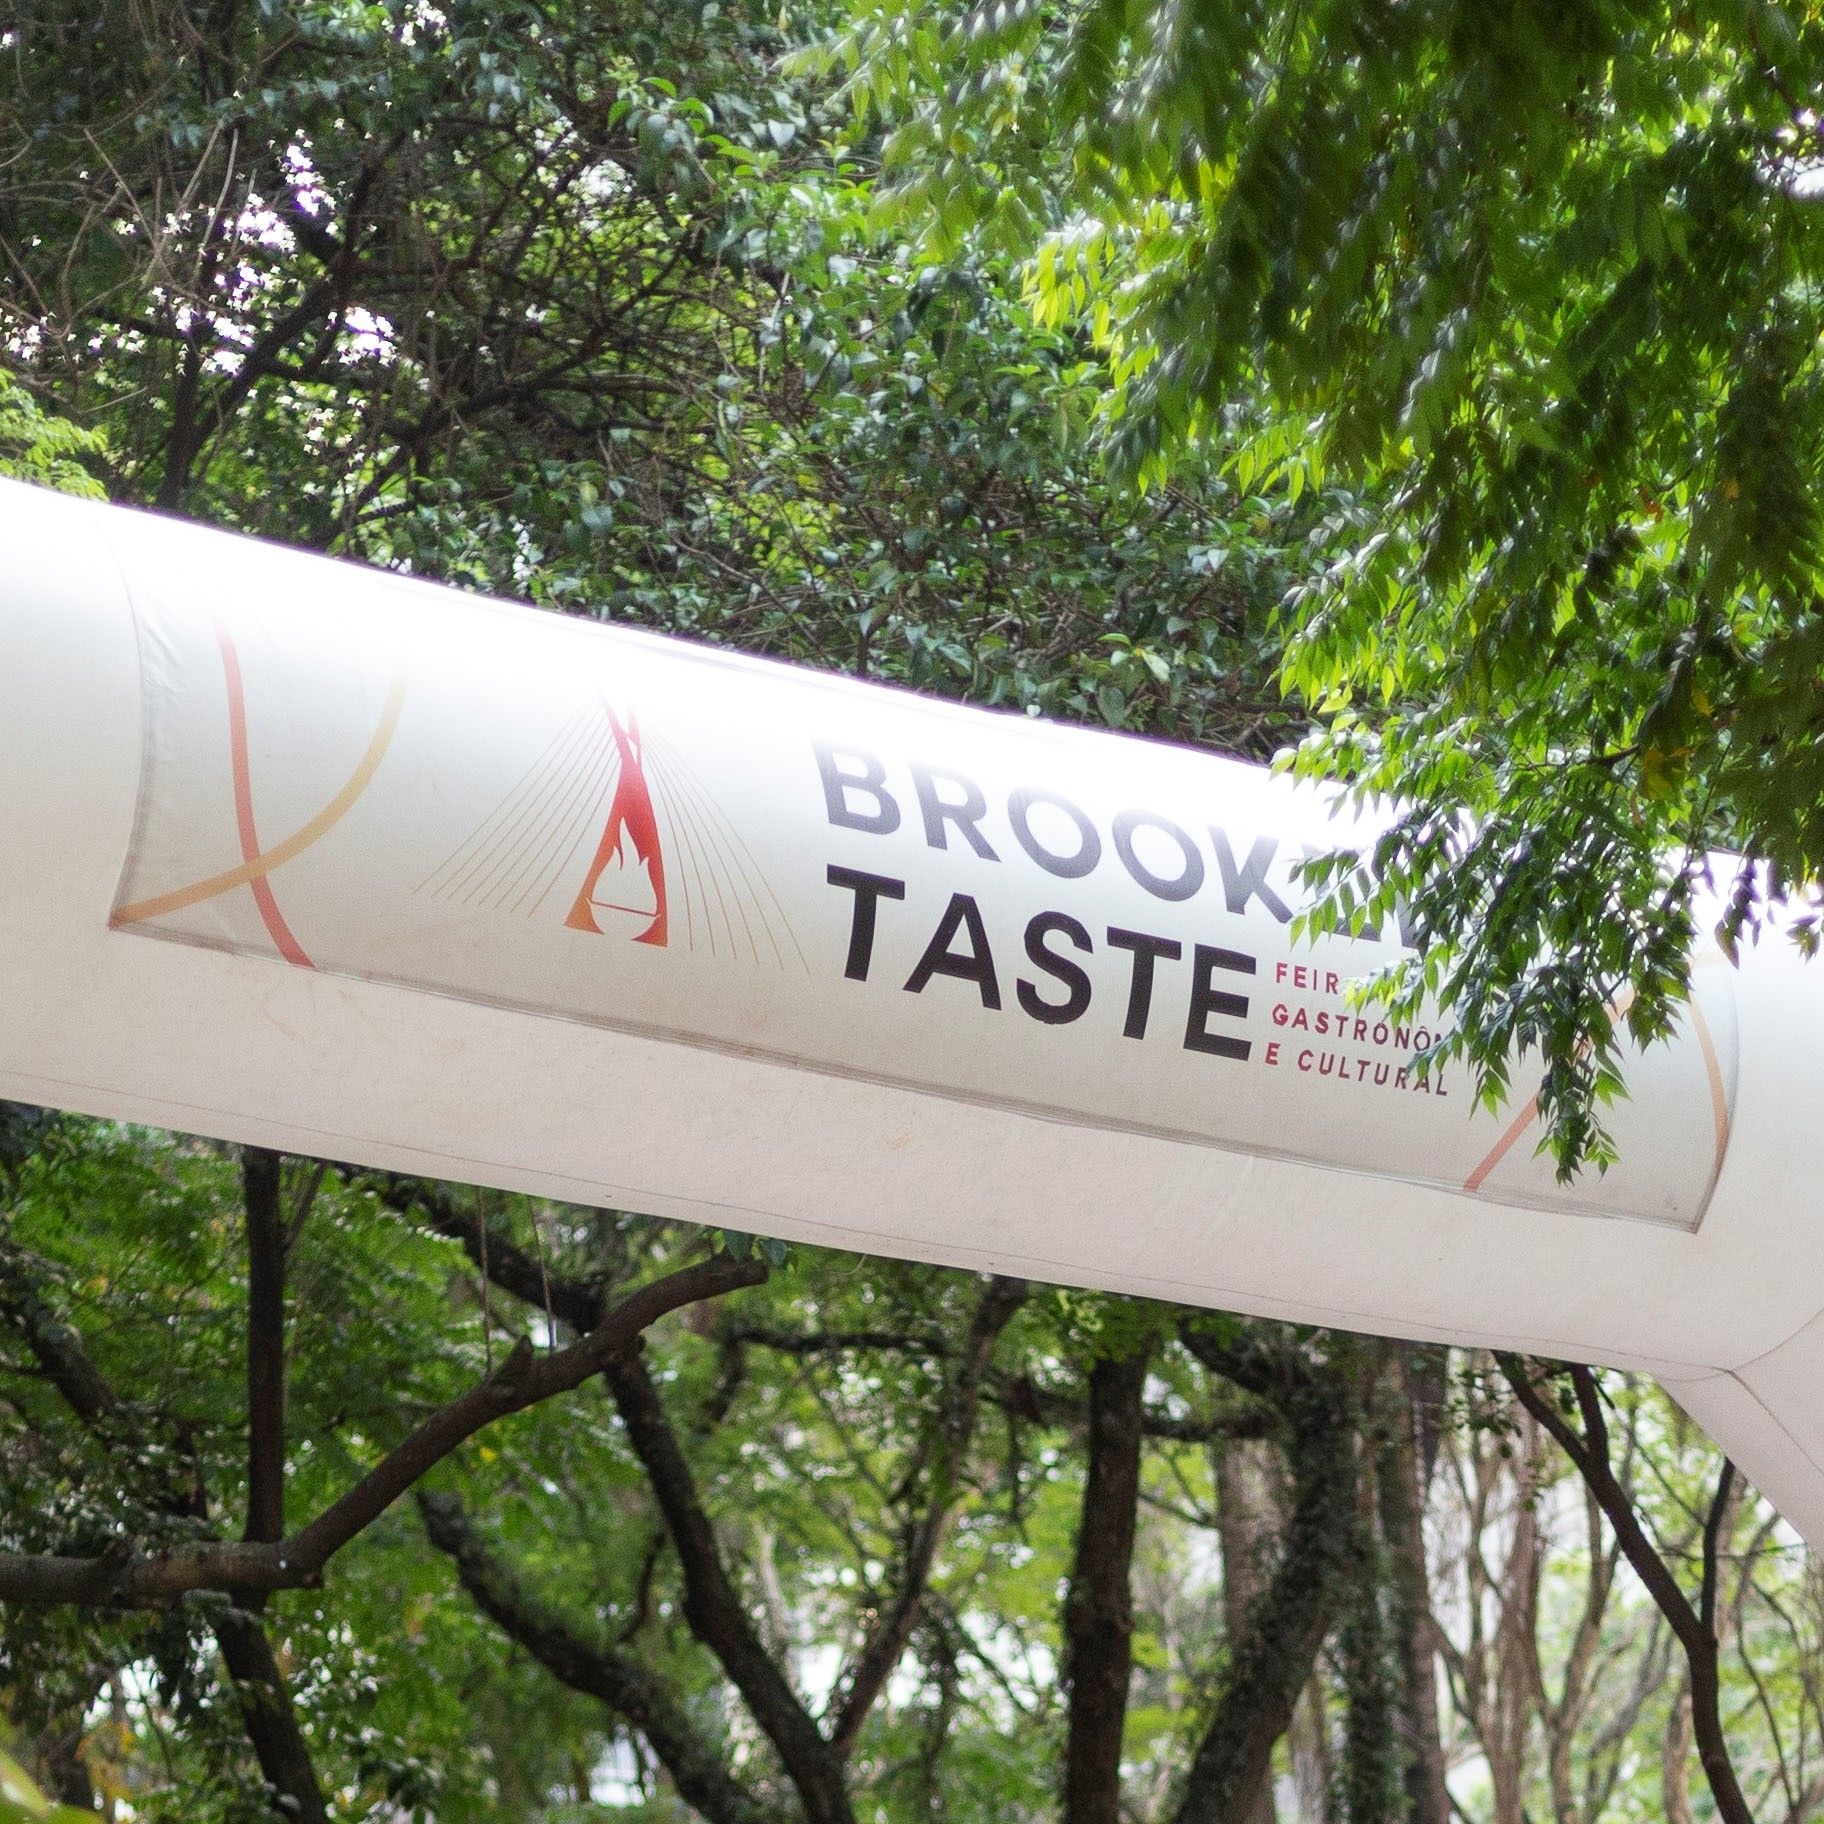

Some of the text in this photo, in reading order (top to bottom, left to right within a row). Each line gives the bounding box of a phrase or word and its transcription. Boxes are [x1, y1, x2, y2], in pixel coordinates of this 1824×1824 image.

[825, 865, 1258, 1062] TASTE
[1275, 962, 1341, 995] FEIR
[1265, 1042, 1281, 1065] E
